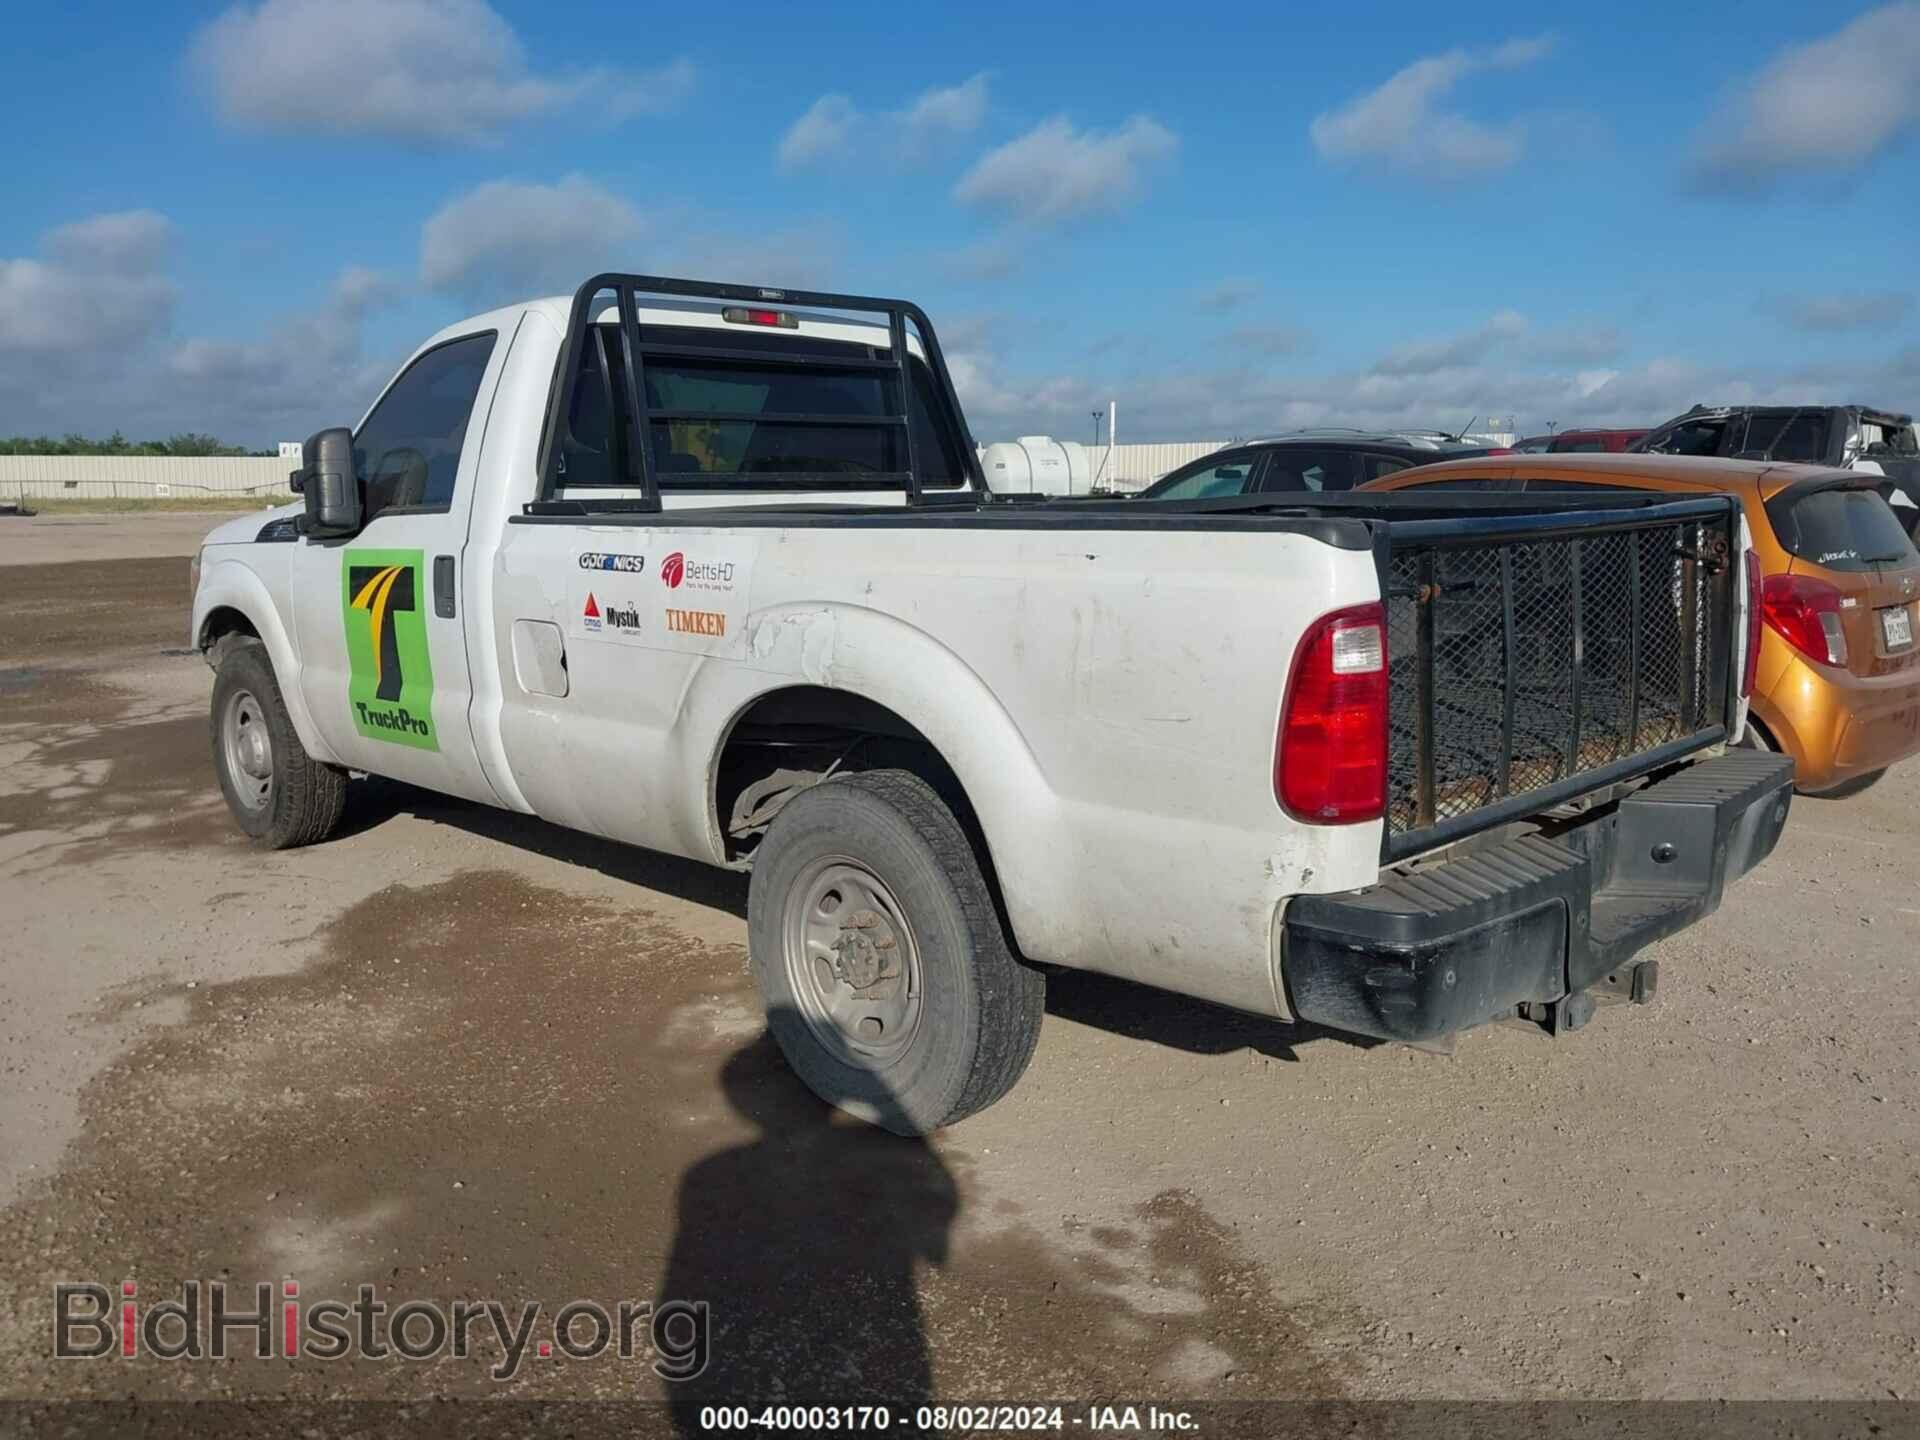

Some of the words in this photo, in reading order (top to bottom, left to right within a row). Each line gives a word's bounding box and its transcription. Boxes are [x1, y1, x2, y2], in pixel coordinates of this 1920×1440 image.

[606, 607, 640, 629] Mystik
[665, 608, 725, 636] TIMKEN
[356, 702, 428, 736] TruckPro
